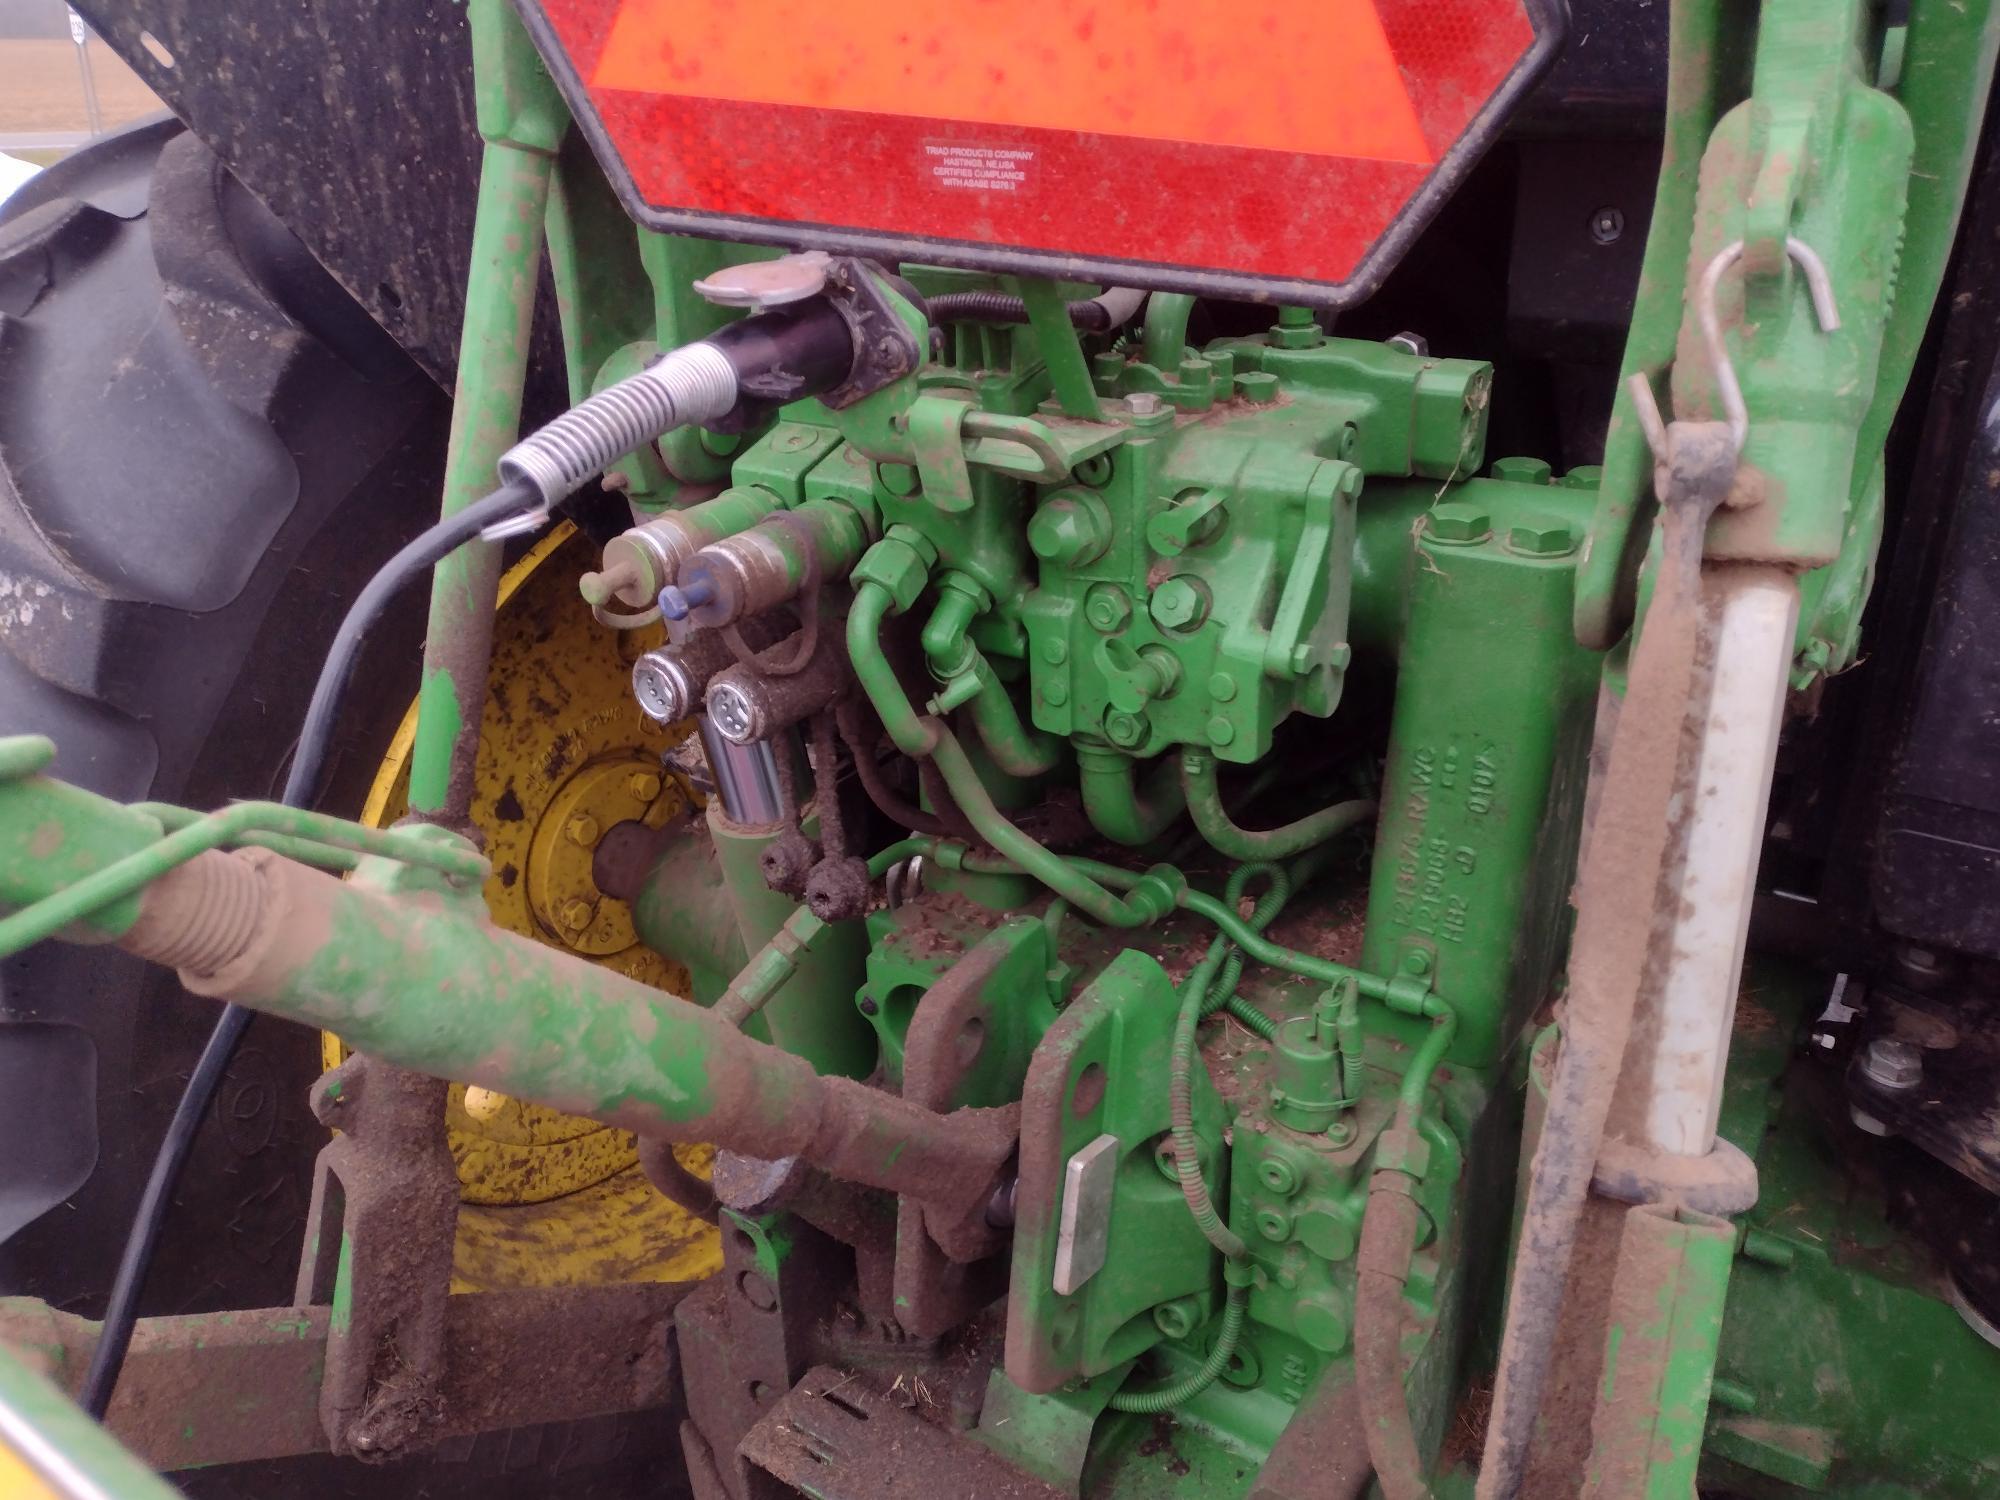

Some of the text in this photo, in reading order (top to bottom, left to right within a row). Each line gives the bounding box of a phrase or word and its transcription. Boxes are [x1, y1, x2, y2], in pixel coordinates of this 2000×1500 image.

[925, 146, 1034, 161] TRIAD PRODUCTS COMPANY
[933, 167, 1025, 180] CERTIFIES COMPLIANCE
[942, 177, 963, 187] WITH
